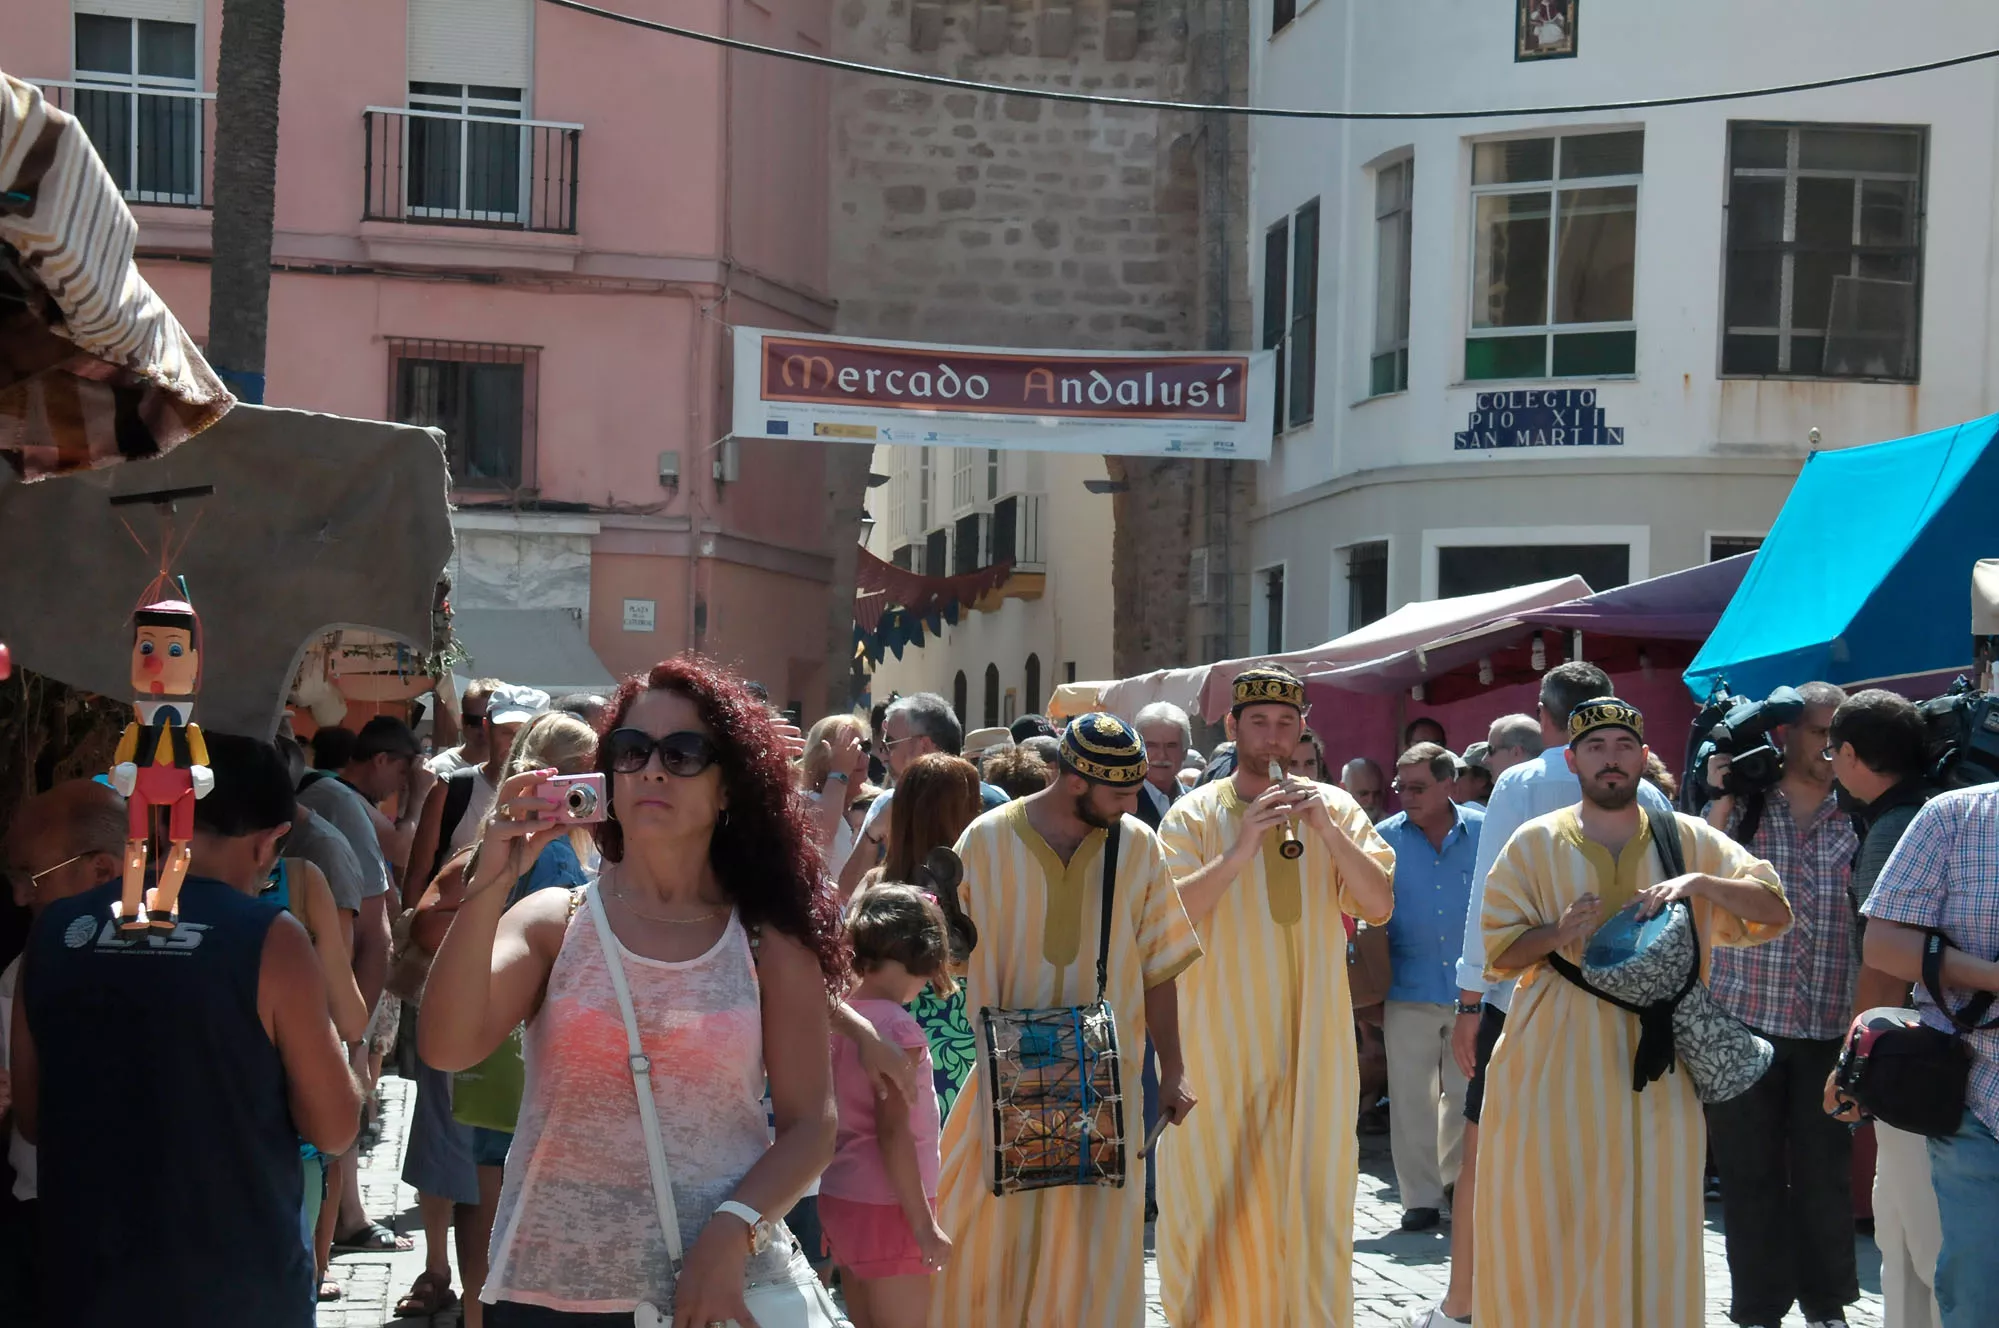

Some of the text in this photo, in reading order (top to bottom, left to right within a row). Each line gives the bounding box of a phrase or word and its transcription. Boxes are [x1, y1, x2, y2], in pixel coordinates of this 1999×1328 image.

[781, 354, 1233, 408] Mercado Andalusí
[1477, 389, 1595, 410] COLEGIO
[1470, 408, 1598, 430] PIO XII
[1455, 428, 1623, 449] SAN MARTIN
